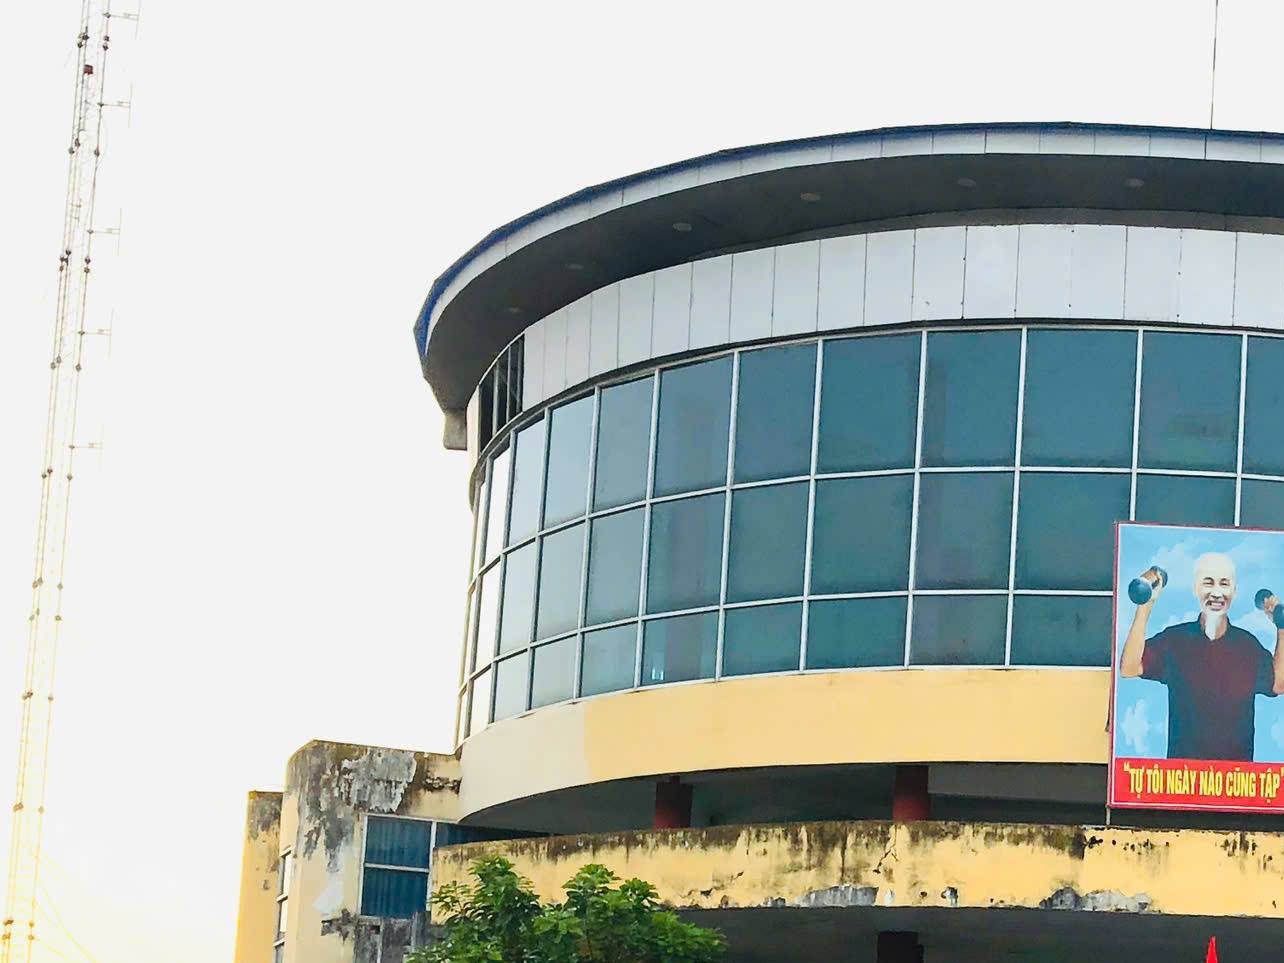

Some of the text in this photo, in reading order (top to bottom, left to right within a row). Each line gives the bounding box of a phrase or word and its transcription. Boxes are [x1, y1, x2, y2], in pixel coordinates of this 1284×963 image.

[1146, 763, 1164, 794] TÔI
[1166, 763, 1197, 795] NGÀY
[1199, 765, 1223, 797] NÀO
[1225, 766, 1256, 798] CŨNG
